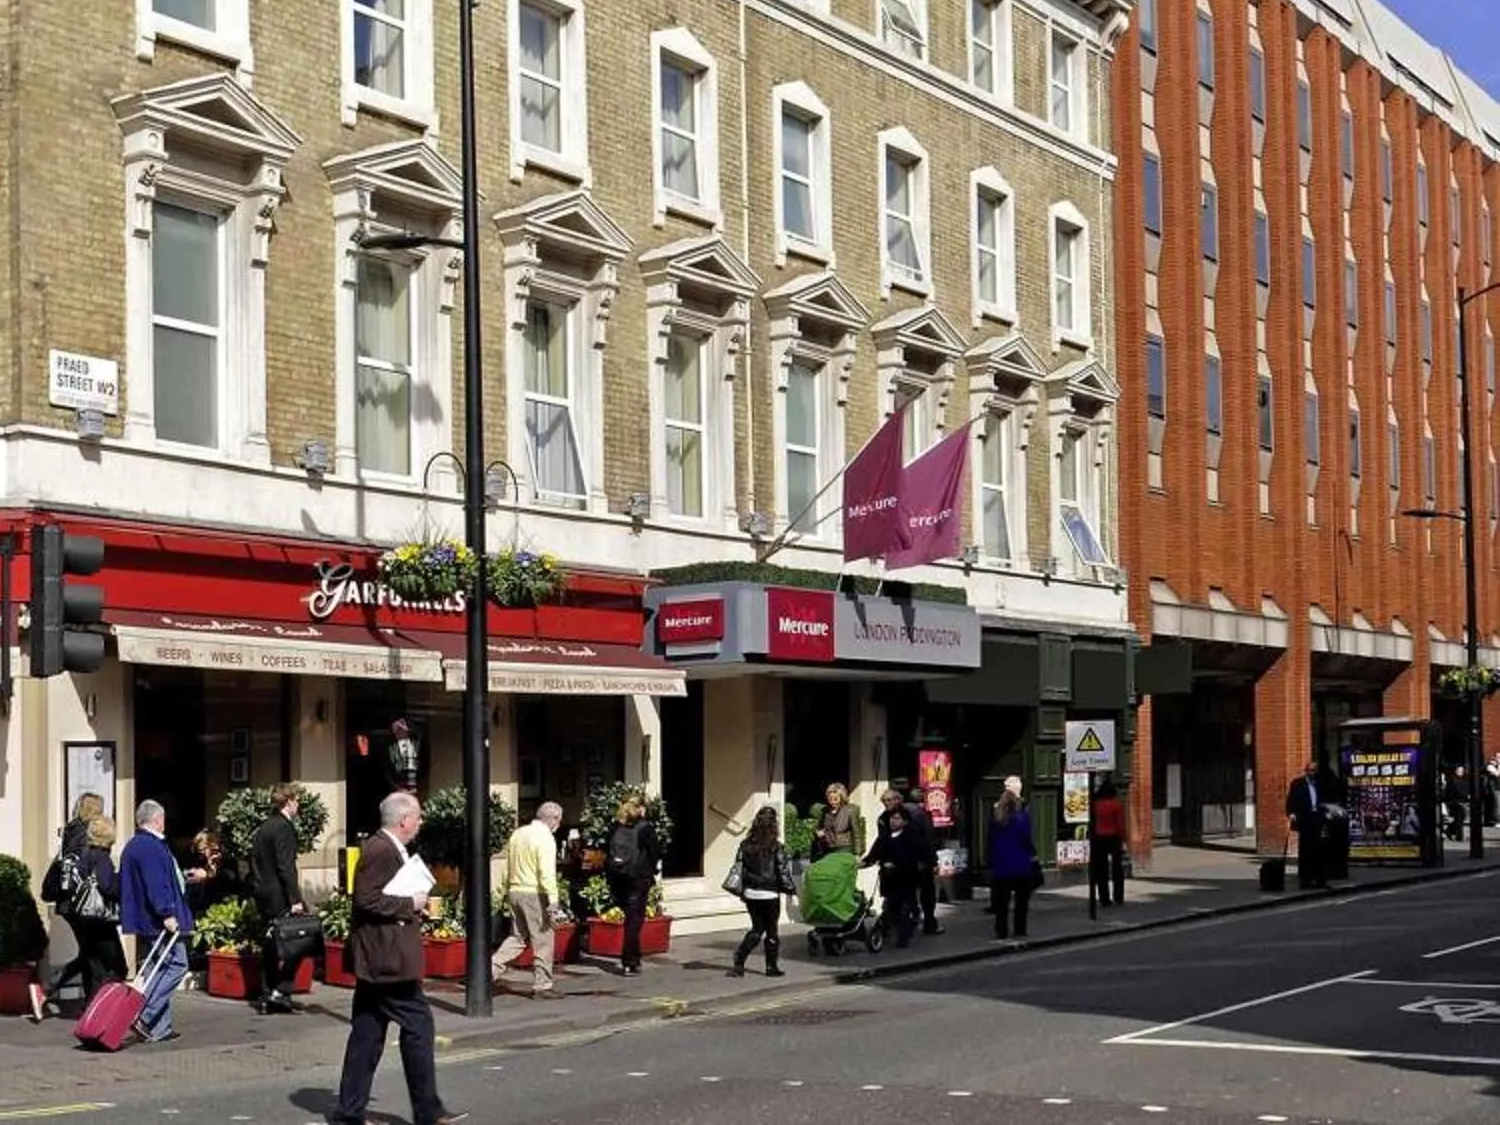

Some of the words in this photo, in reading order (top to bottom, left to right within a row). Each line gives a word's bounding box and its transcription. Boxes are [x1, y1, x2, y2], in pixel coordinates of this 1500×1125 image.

[56, 356, 89, 375] PRAED
[56, 373, 93, 392] STREET
[97, 380, 115, 396] W2
[664, 616, 713, 628] Mercure
[778, 616, 830, 636] Mercure
[155, 646, 192, 661] BEERS
[211, 650, 244, 665] WINES
[261, 653, 307, 669] COFFEES
[322, 658, 347, 673] TEAS
